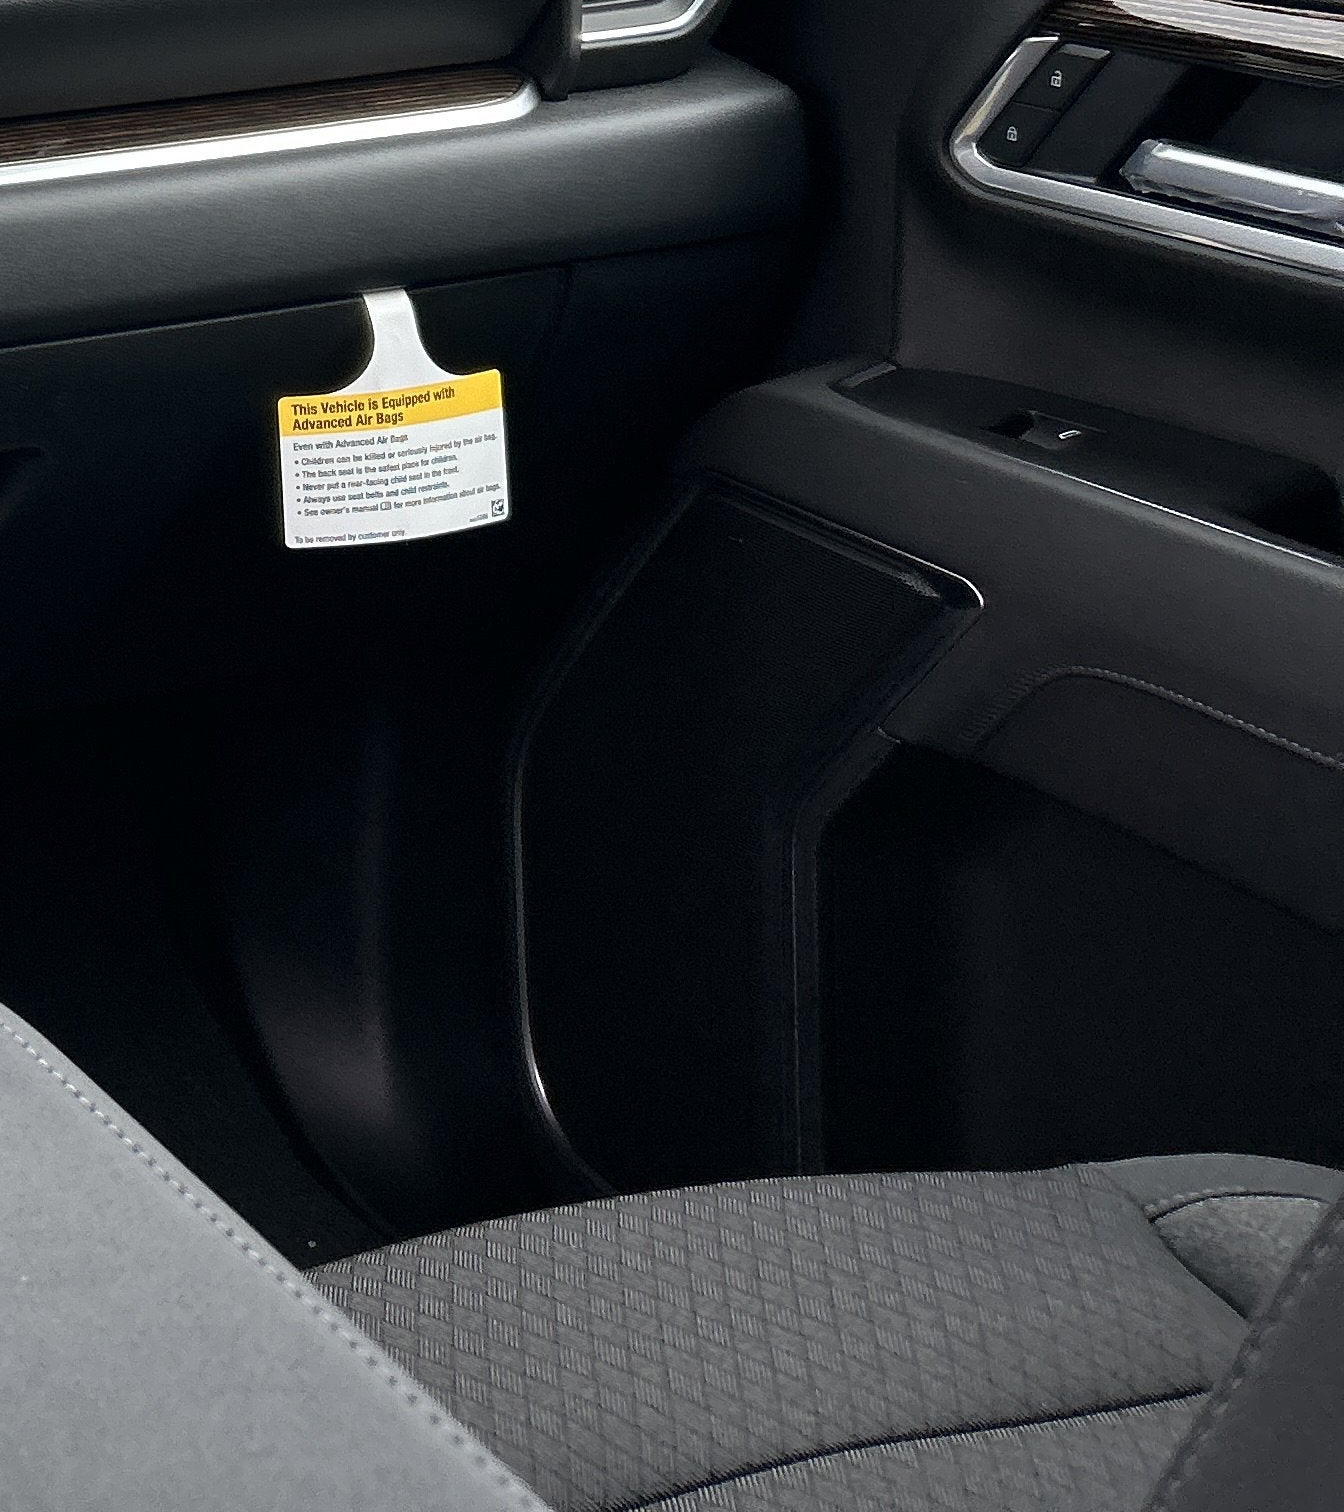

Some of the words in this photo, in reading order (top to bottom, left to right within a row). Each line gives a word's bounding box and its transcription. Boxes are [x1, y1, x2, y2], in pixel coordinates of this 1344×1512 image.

[291, 403, 317, 416] This
[321, 399, 364, 414] Vehicle
[368, 397, 378, 410] is
[382, 391, 430, 410] Equipped
[433, 386, 455, 401] with
[292, 415, 352, 431] Advanced
[356, 413, 373, 427] Air
[376, 412, 404, 425] Bags
[293, 442, 313, 451] Even
[315, 440, 333, 449] with
[335, 437, 375, 448] Advanced
[376, 436, 388, 445] Air
[301, 457, 334, 466] Children
